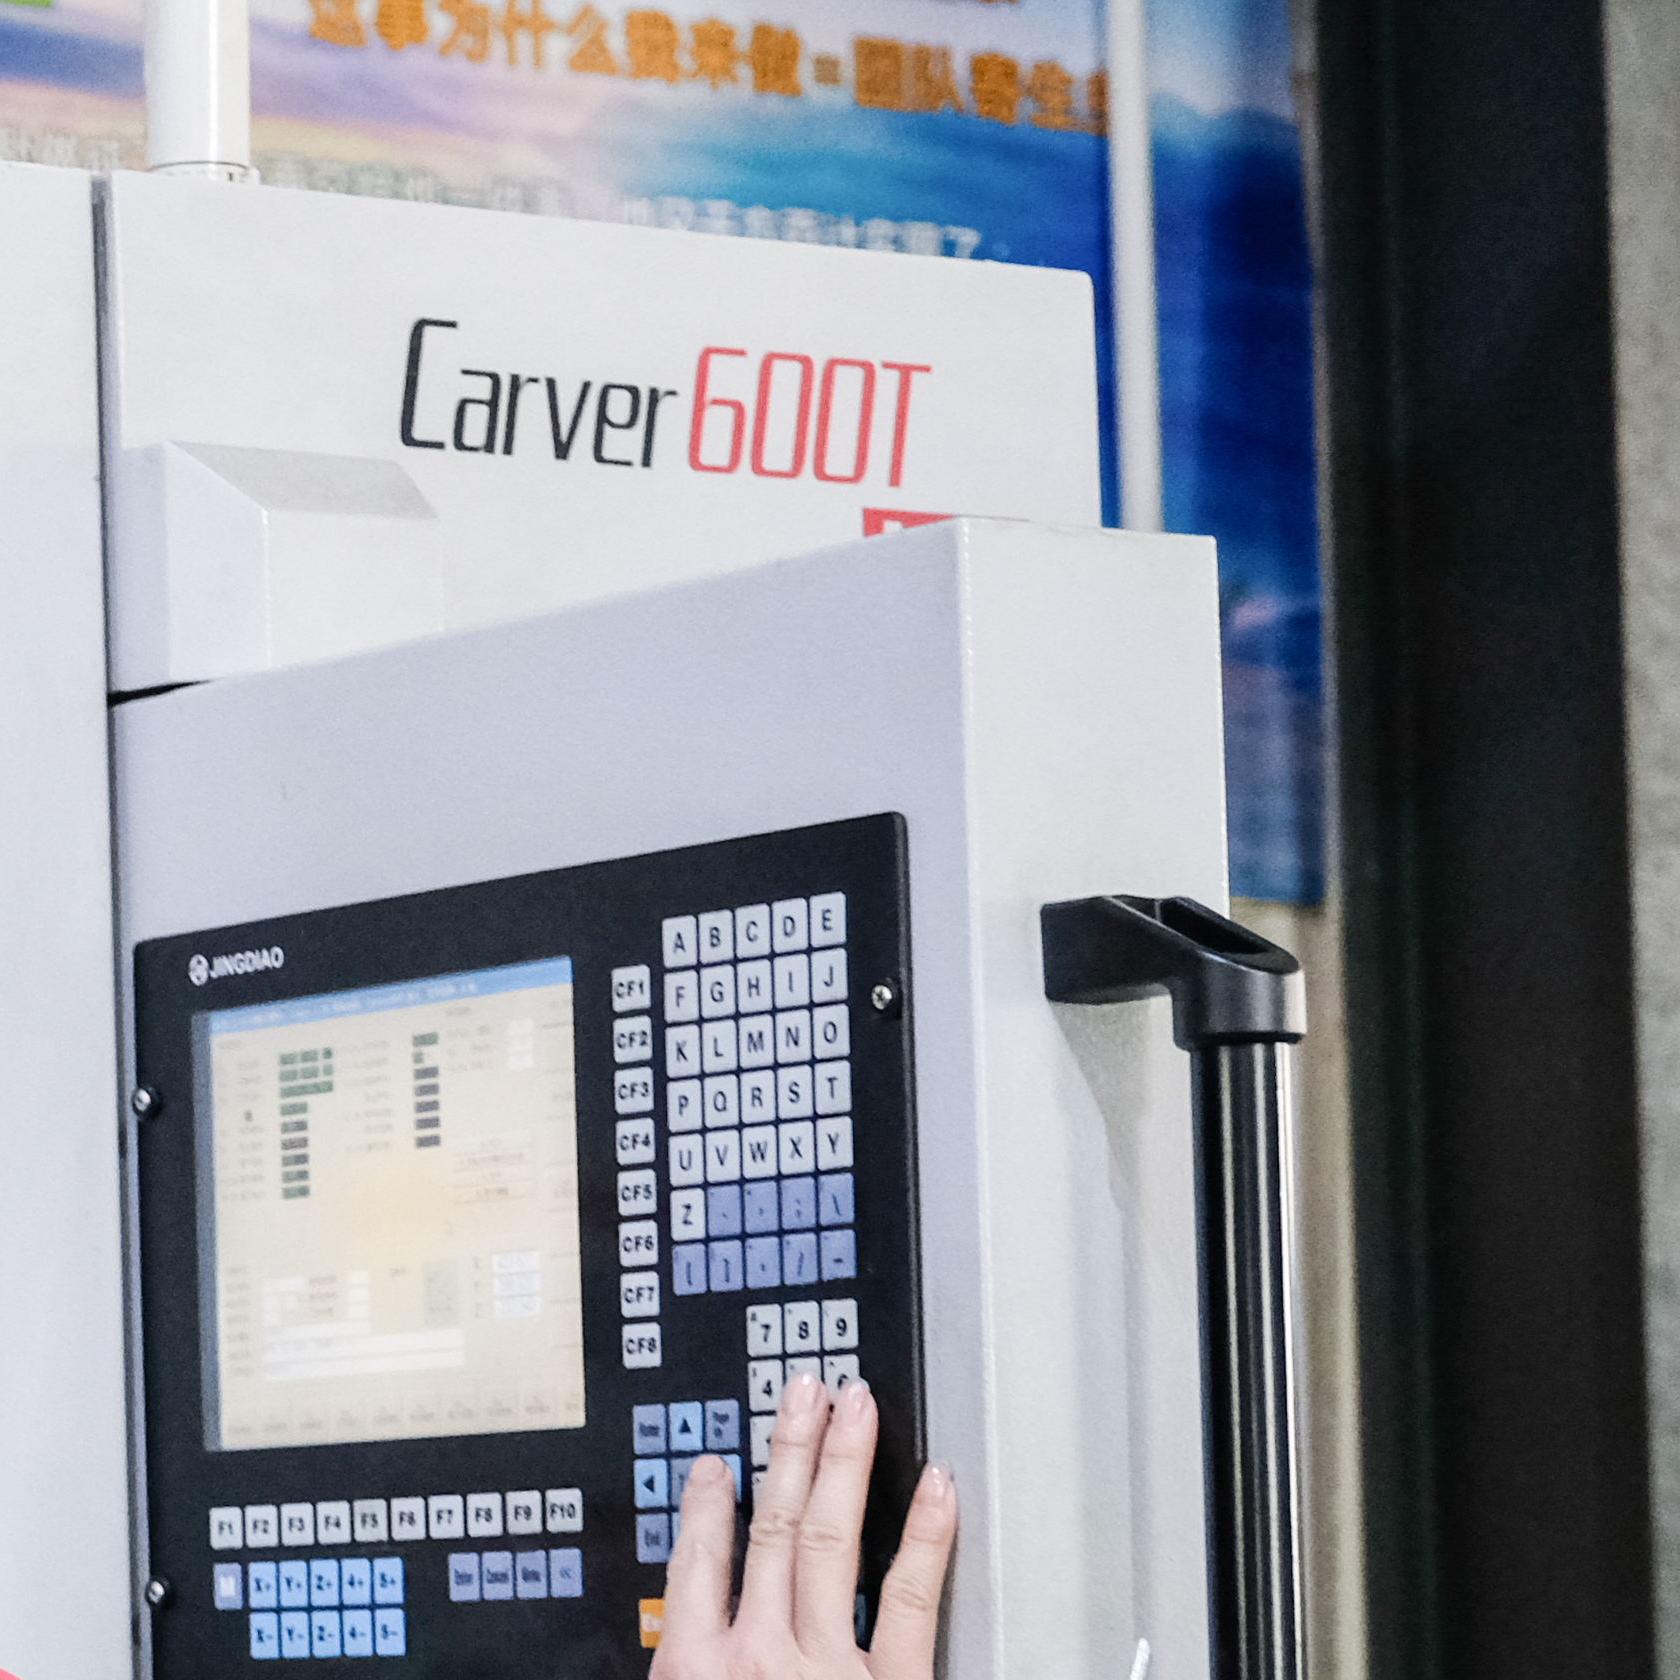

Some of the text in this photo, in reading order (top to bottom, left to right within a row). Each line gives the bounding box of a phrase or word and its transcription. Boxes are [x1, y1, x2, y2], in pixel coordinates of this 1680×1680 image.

[674, 908, 833, 952] A B C D E
[615, 980, 644, 999] CF1
[675, 965, 834, 1008] F G H I J
[616, 1030, 648, 1050] CF2
[676, 1020, 838, 1061] K L M N O
[617, 1081, 650, 1101] CF3
[678, 1076, 838, 1116] P Q R S T
[619, 1133, 651, 1151] CF4
[678, 1133, 839, 1172] U V W X Y
[620, 1183, 653, 1202] CF5
[682, 1203, 693, 1226] Z
[622, 1234, 654, 1253] CF6
[623, 1285, 655, 1304] CF7
[760, 1317, 848, 1343] 7 8 9
[625, 1337, 657, 1355] CF8
[217, 1502, 576, 1536] F1 F2 F3 F4 F5 F6 F7 F8 F9 F10
